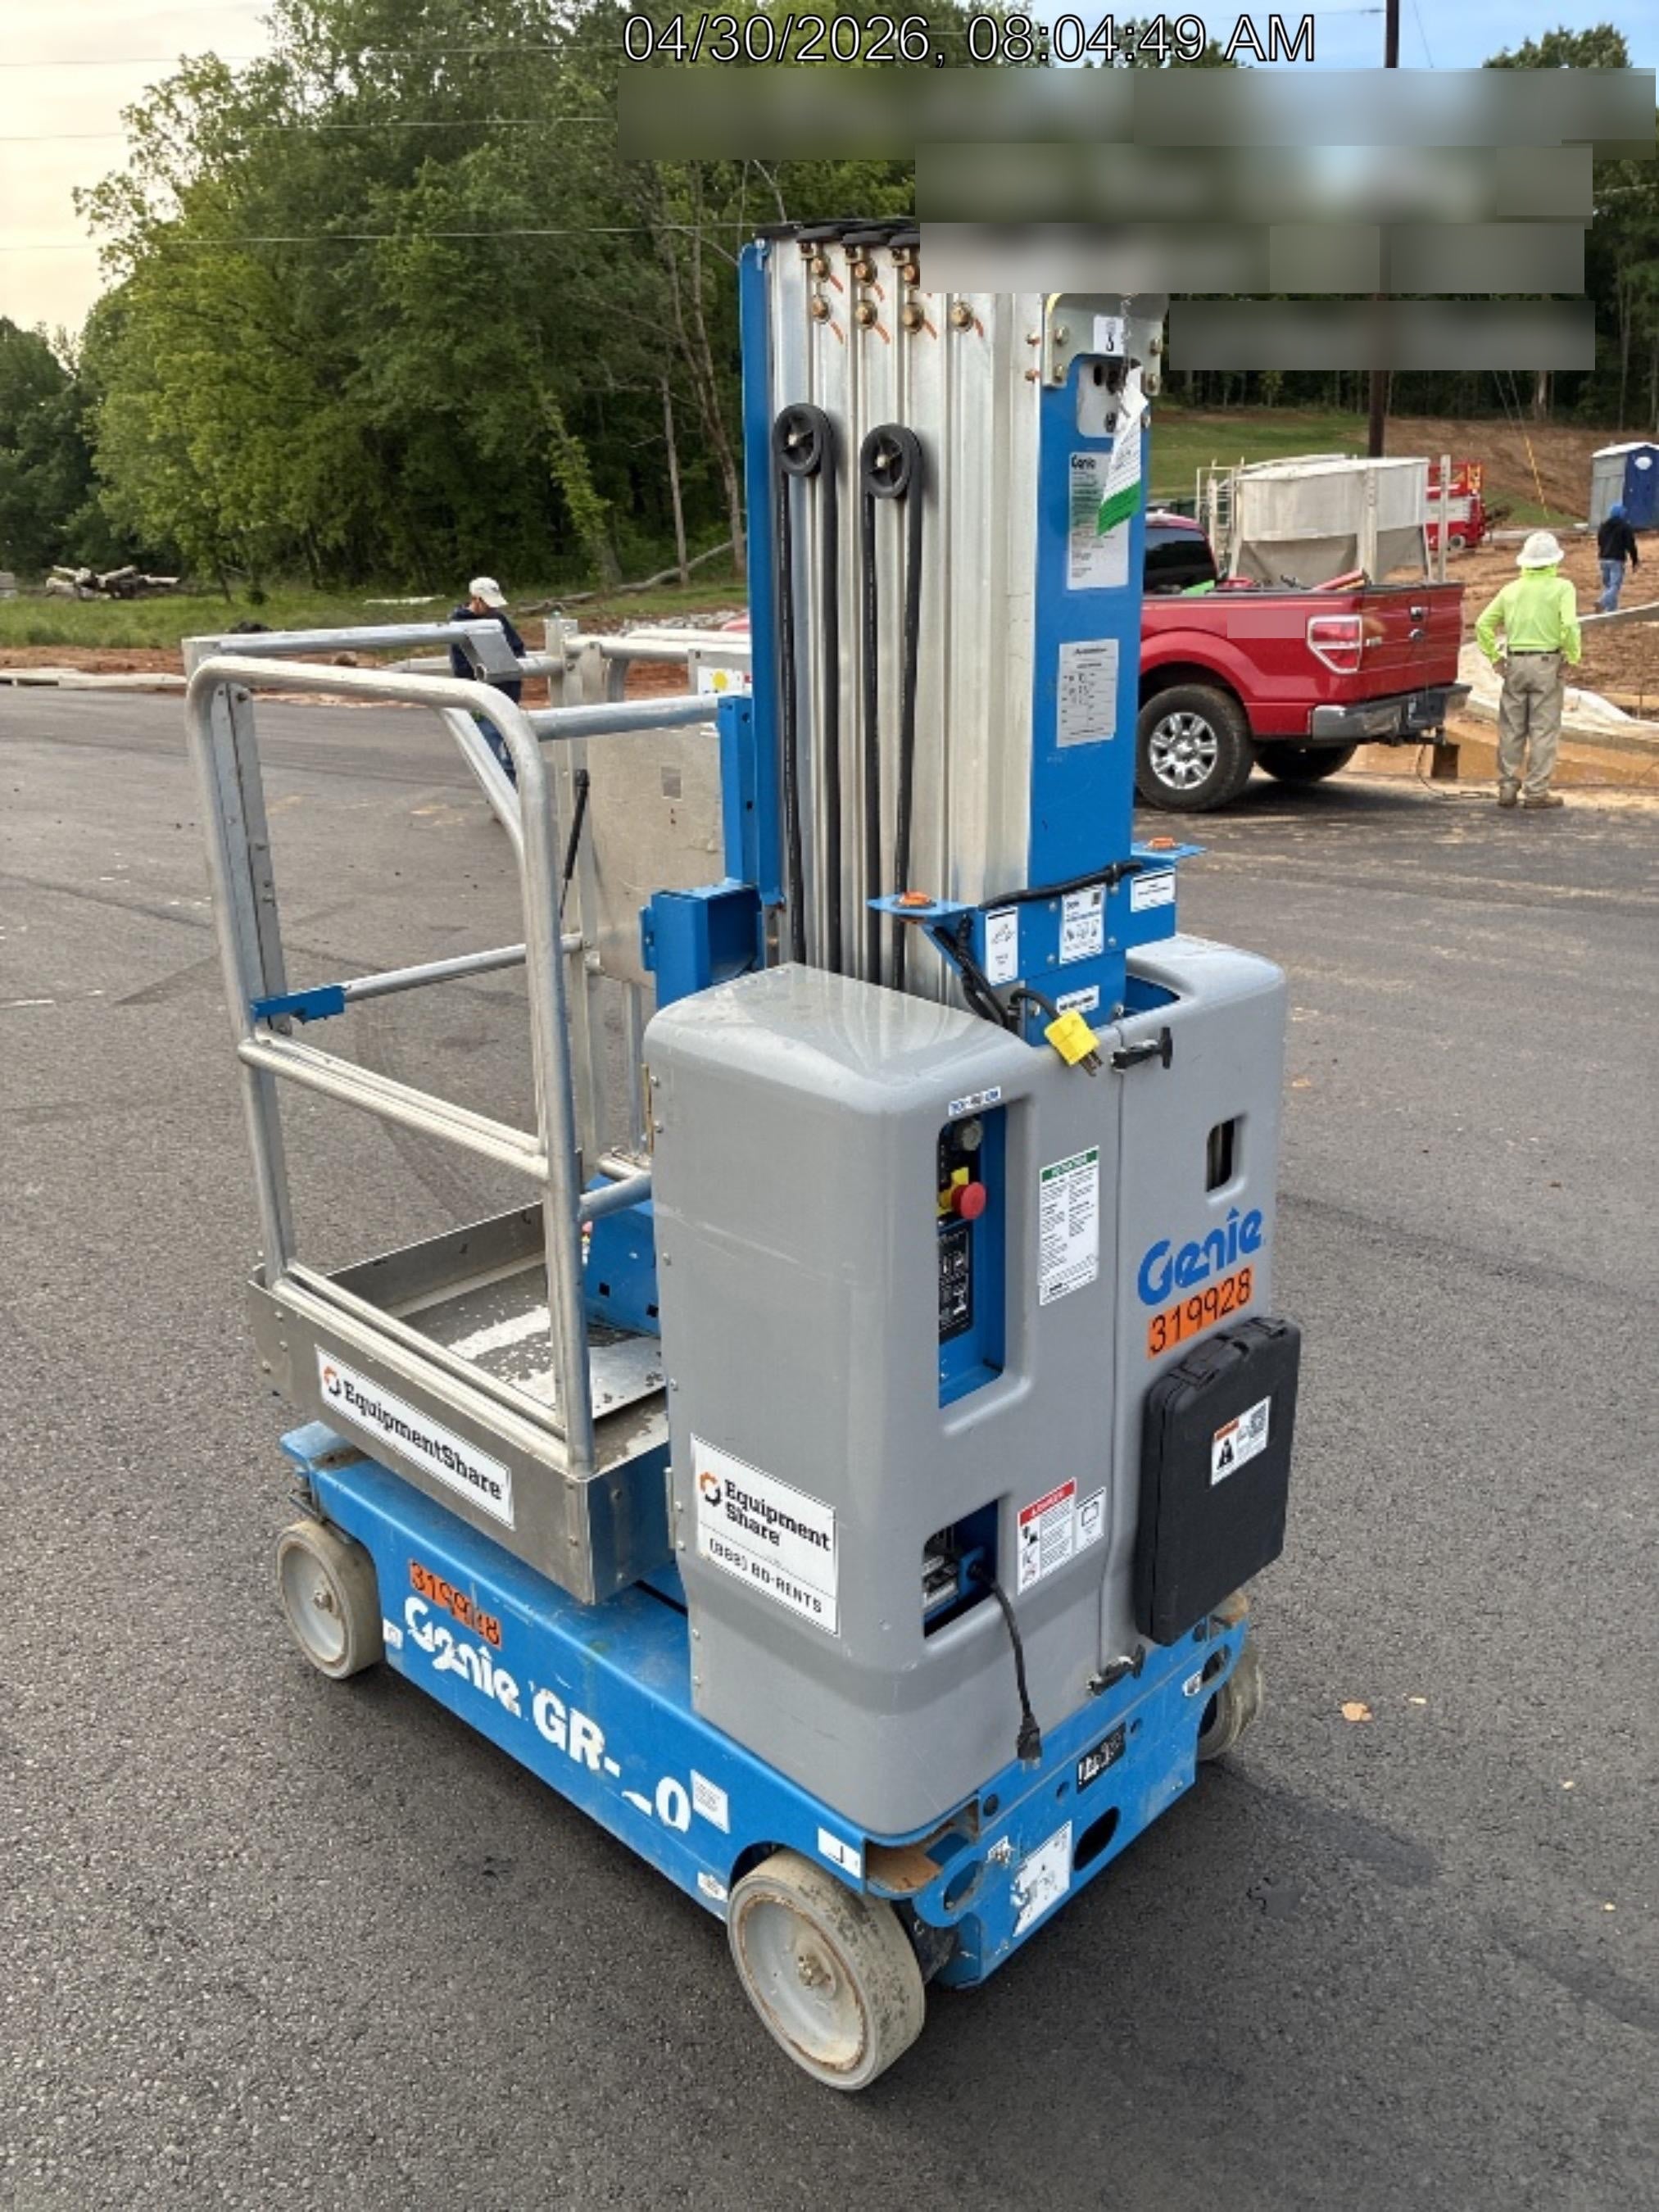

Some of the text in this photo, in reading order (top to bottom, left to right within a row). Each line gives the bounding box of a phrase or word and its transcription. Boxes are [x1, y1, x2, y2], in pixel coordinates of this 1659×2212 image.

[1138, 1206, 1262, 1306] Genie
[1149, 1267, 1252, 1355] 319928
[343, 1380, 502, 1501] EquipmentShare
[724, 1478, 832, 1551] Equipment
[725, 1502, 781, 1547] Share
[404, 1596, 522, 1719] Genie
